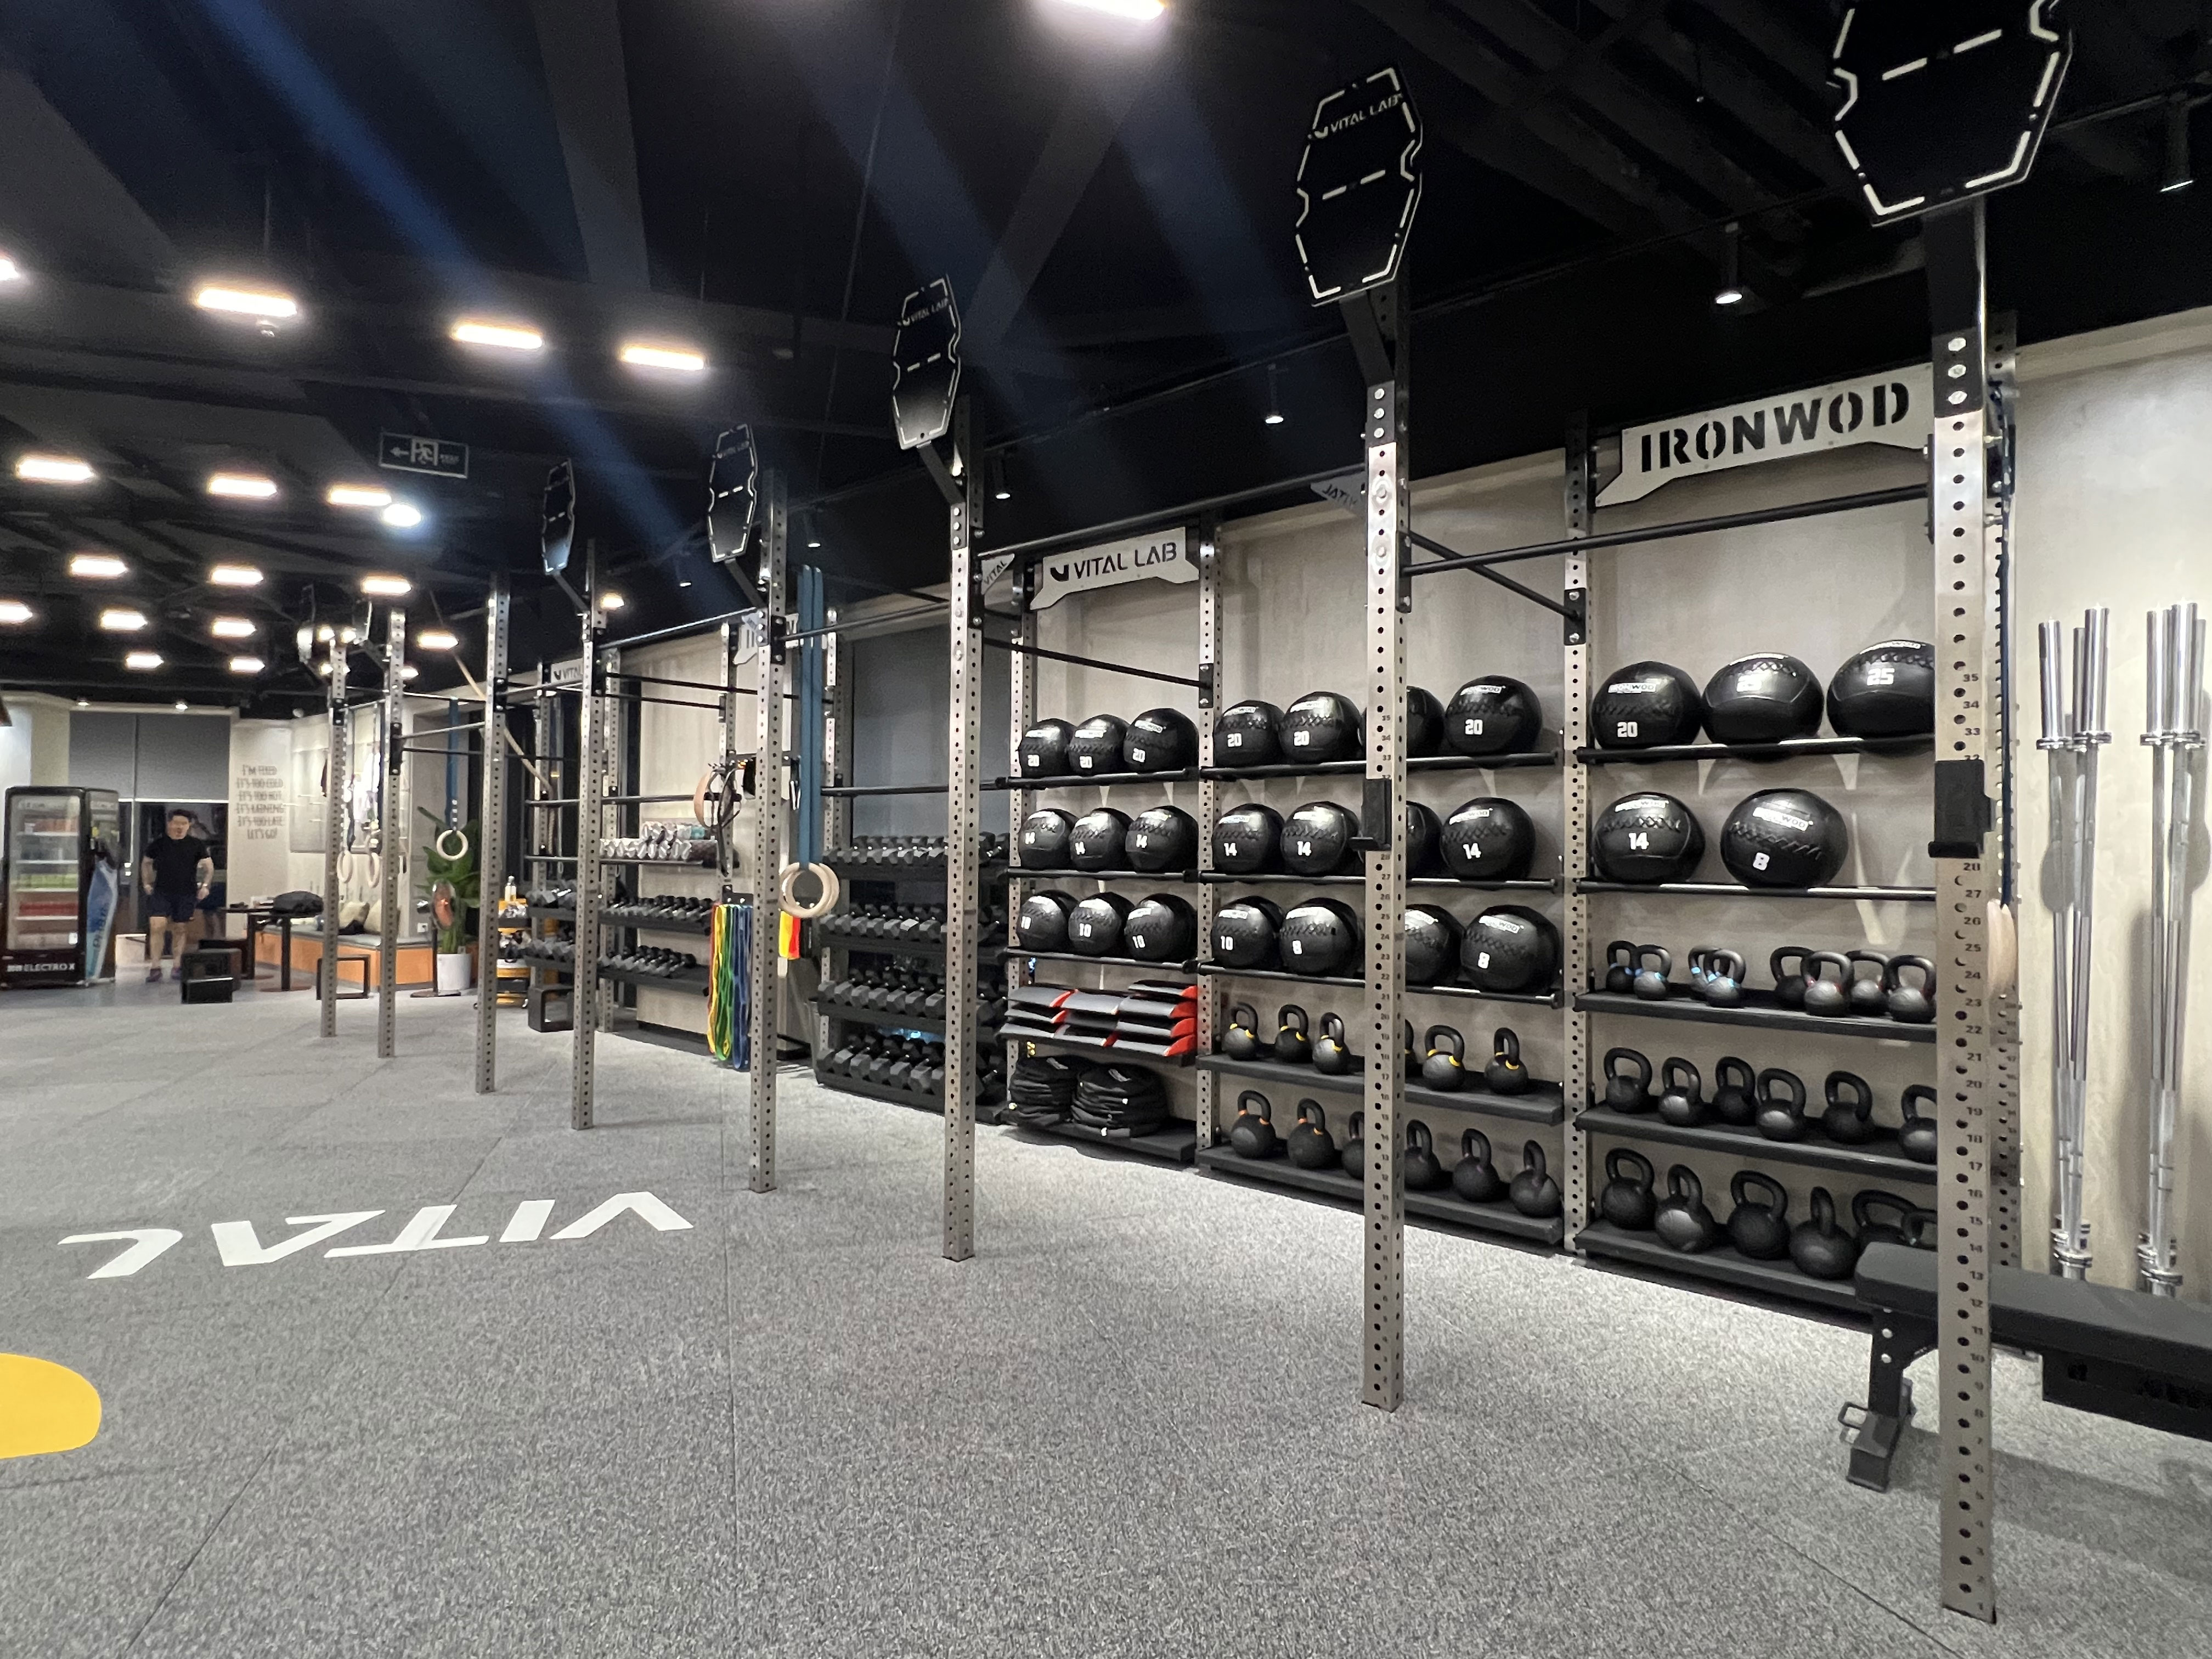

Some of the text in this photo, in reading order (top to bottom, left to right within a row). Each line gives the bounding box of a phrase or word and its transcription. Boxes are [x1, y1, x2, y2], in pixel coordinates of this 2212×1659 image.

[1331, 113, 1366, 133] VITAL
[1641, 382, 1909, 473] IRONWOD
[1074, 542, 1177, 579] VITAL LAB
[983, 560, 1008, 585] VITAL
[1867, 667, 1894, 685] 25
[1963, 674, 1978, 682] 35
[1963, 701, 1979, 709] 34
[1465, 719, 1482, 735] 20
[1618, 722, 1637, 737] 20
[1228, 733, 1242, 747] 20
[1294, 731, 1310, 746] 20
[1028, 755, 1039, 766] 20
[1133, 748, 1145, 762] 20
[1080, 757, 1092, 768] 20
[1025, 832, 1035, 844] 14
[1136, 834, 1147, 848] 14
[1629, 833, 1649, 849] 14
[1075, 842, 1085, 854] 14
[1224, 843, 1237, 856] 14
[1297, 841, 1311, 856] 14
[1463, 843, 1481, 859] 14
[1753, 853, 1769, 870] 8
[1966, 890, 1981, 898] 27
[1080, 923, 1091, 937] 10
[1133, 935, 1145, 948] 10
[1221, 936, 1233, 950] 10
[1966, 944, 1981, 952] 25
[1478, 952, 1489, 968] 8
[1965, 970, 1980, 979] 24
[1966, 998, 1982, 1007] 23
[1966, 1025, 1982, 1034] 22
[1967, 1053, 1981, 1061] 21
[1966, 1080, 1982, 1088] 20
[1967, 1107, 1982, 1115] 19
[1967, 1135, 1982, 1143] 18
[1969, 1161, 1982, 1171] 17
[58, 1192, 694, 1279] VITAL
